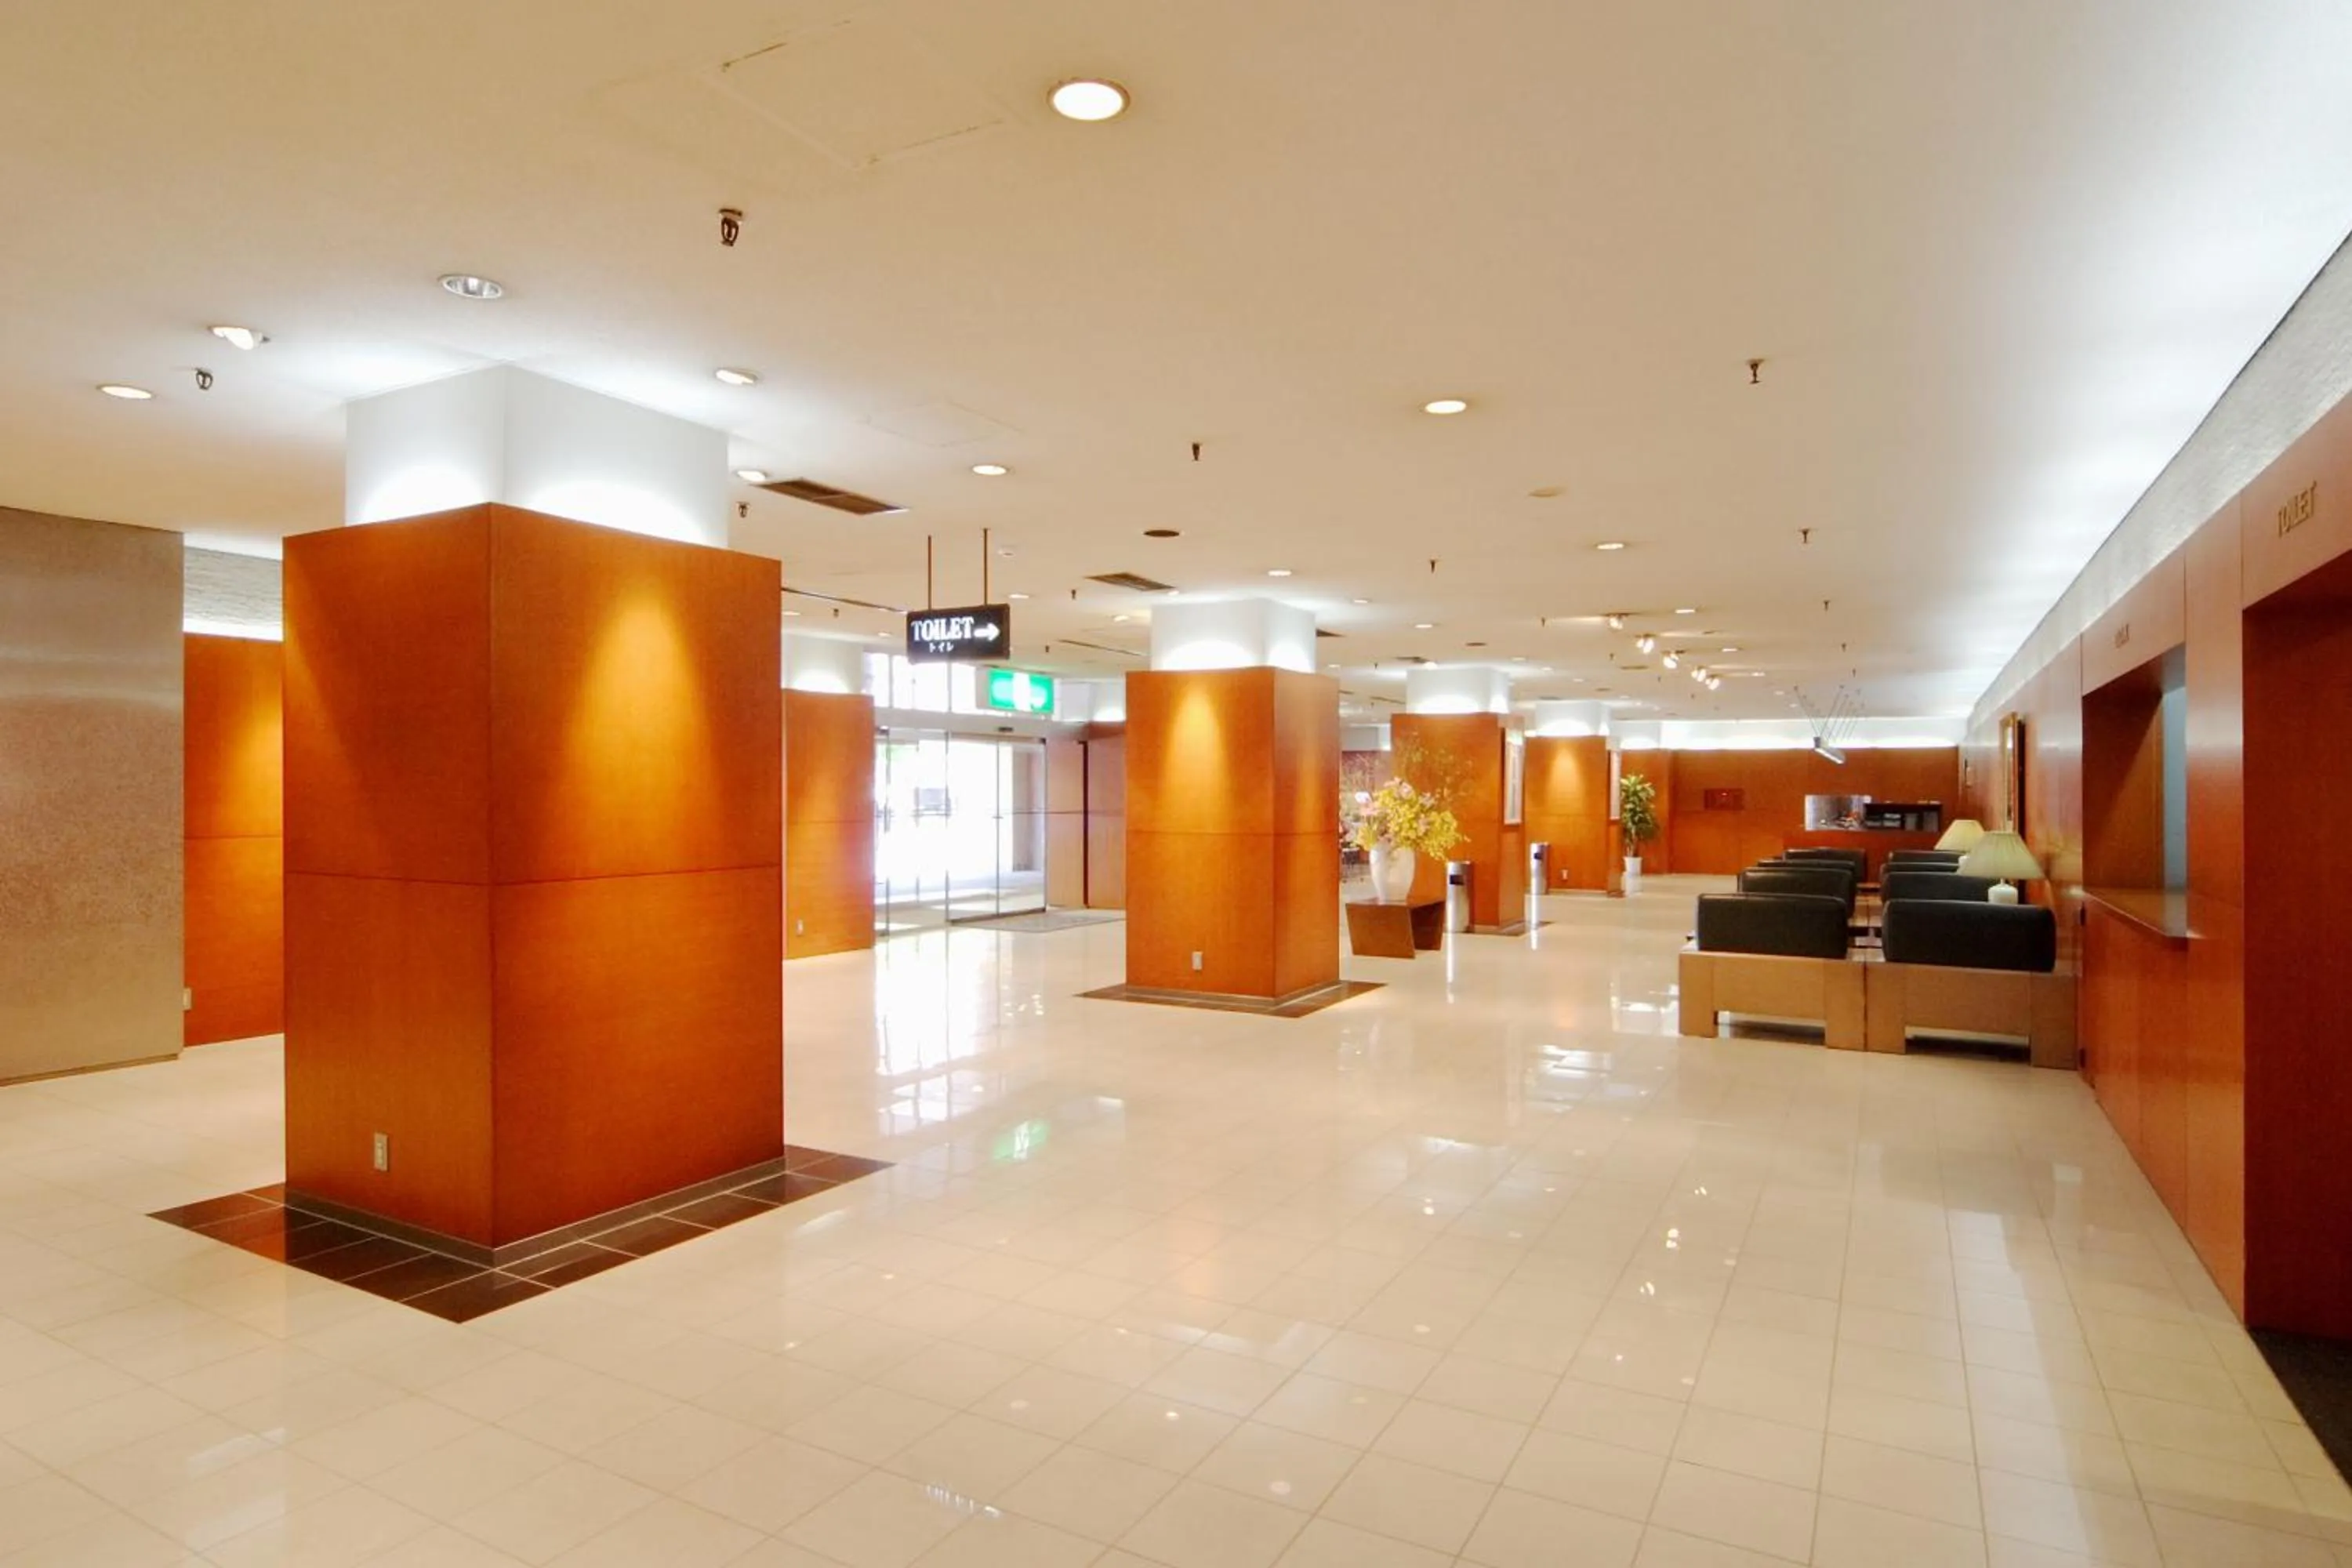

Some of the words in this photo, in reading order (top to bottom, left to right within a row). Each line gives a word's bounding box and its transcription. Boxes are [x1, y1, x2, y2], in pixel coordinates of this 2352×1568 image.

[2277, 479, 2317, 539] TOILET
[911, 616, 975, 641] TOILET
[929, 641, 954, 653] トイレ
